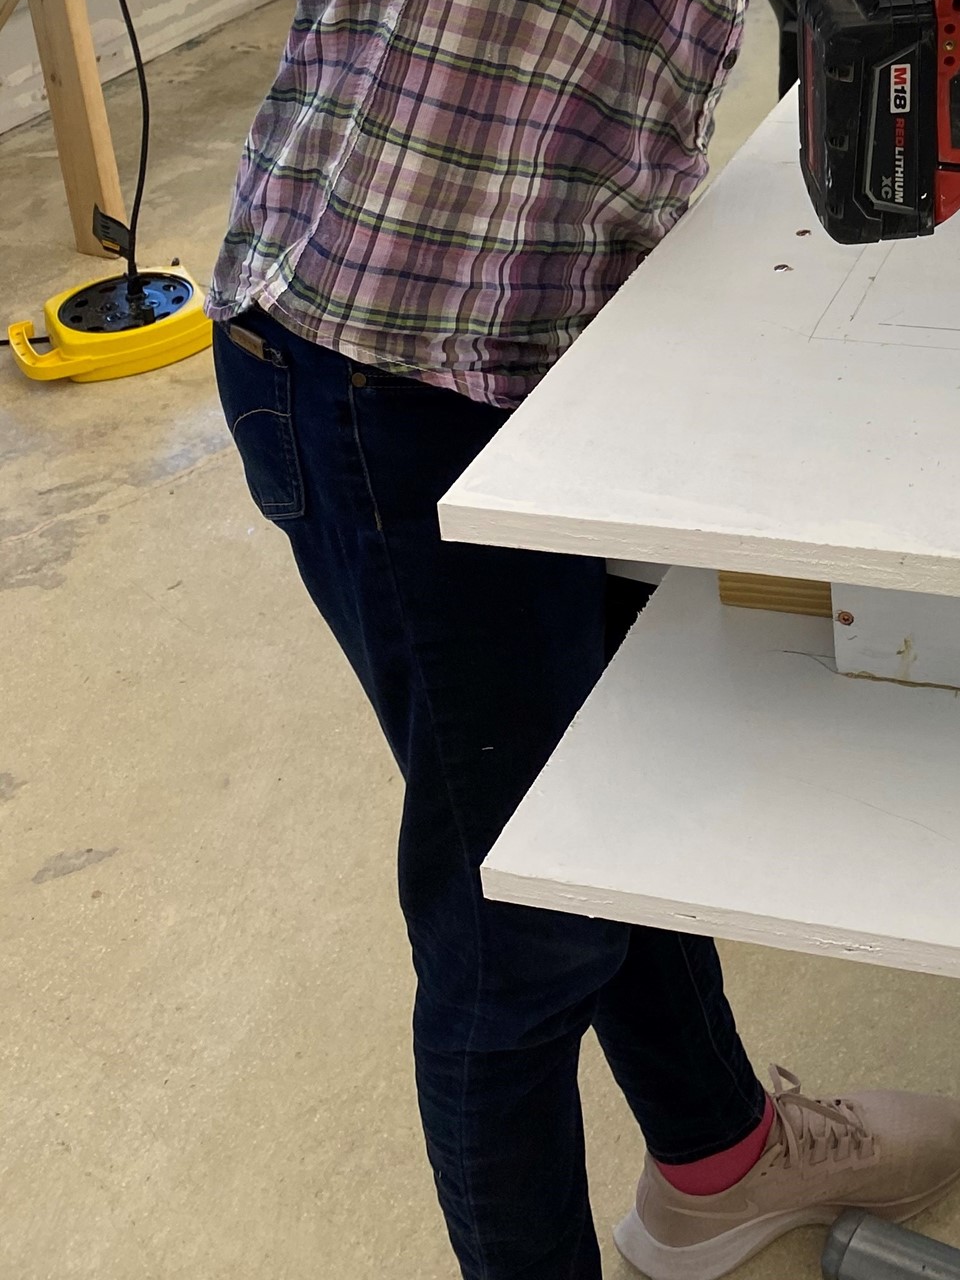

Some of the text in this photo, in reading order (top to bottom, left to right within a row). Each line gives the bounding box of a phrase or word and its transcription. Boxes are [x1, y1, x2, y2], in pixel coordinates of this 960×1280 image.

[893, 67, 907, 203] M18 REDLITHIUM
[881, 176, 892, 200] XC
